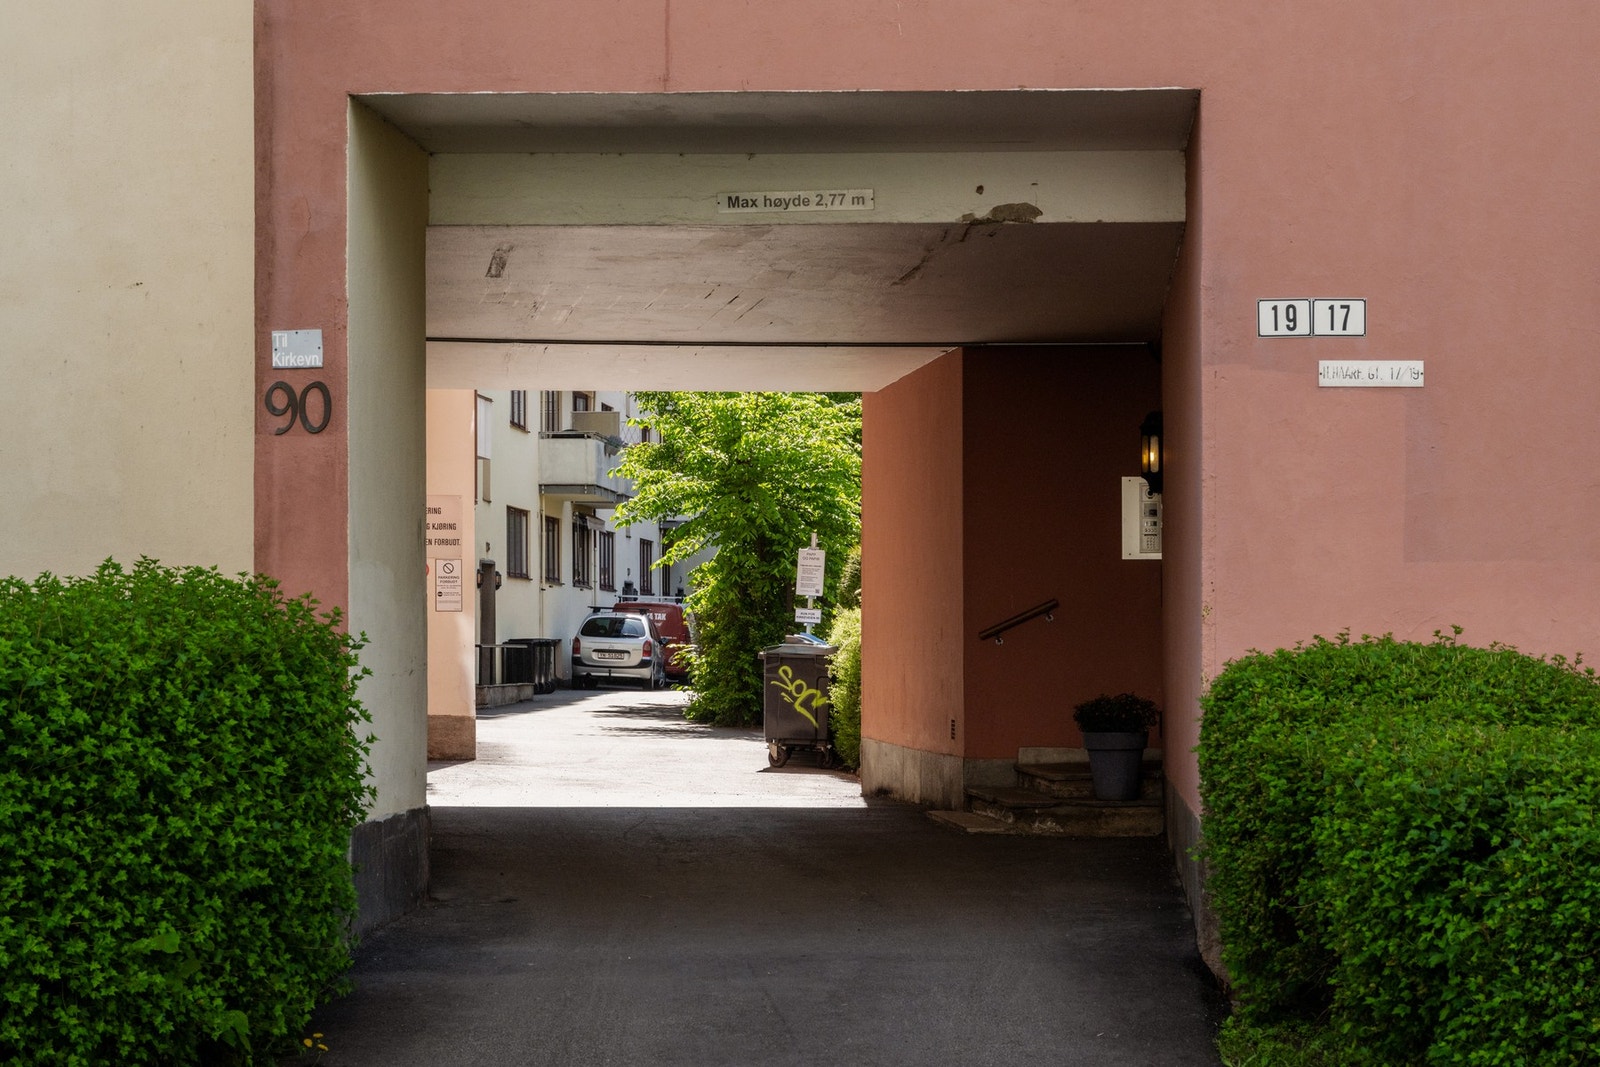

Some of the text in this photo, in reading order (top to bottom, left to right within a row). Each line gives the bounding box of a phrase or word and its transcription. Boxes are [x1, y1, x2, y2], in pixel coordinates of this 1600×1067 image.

[727, 193, 865, 210] Max høyde 2,77 m
[1271, 303, 1298, 331] 19
[1328, 304, 1351, 331] 17
[273, 333, 288, 347] Til
[272, 352, 322, 367] Kirkevn.
[265, 381, 332, 436] 90
[654, 612, 666, 620] TAK
